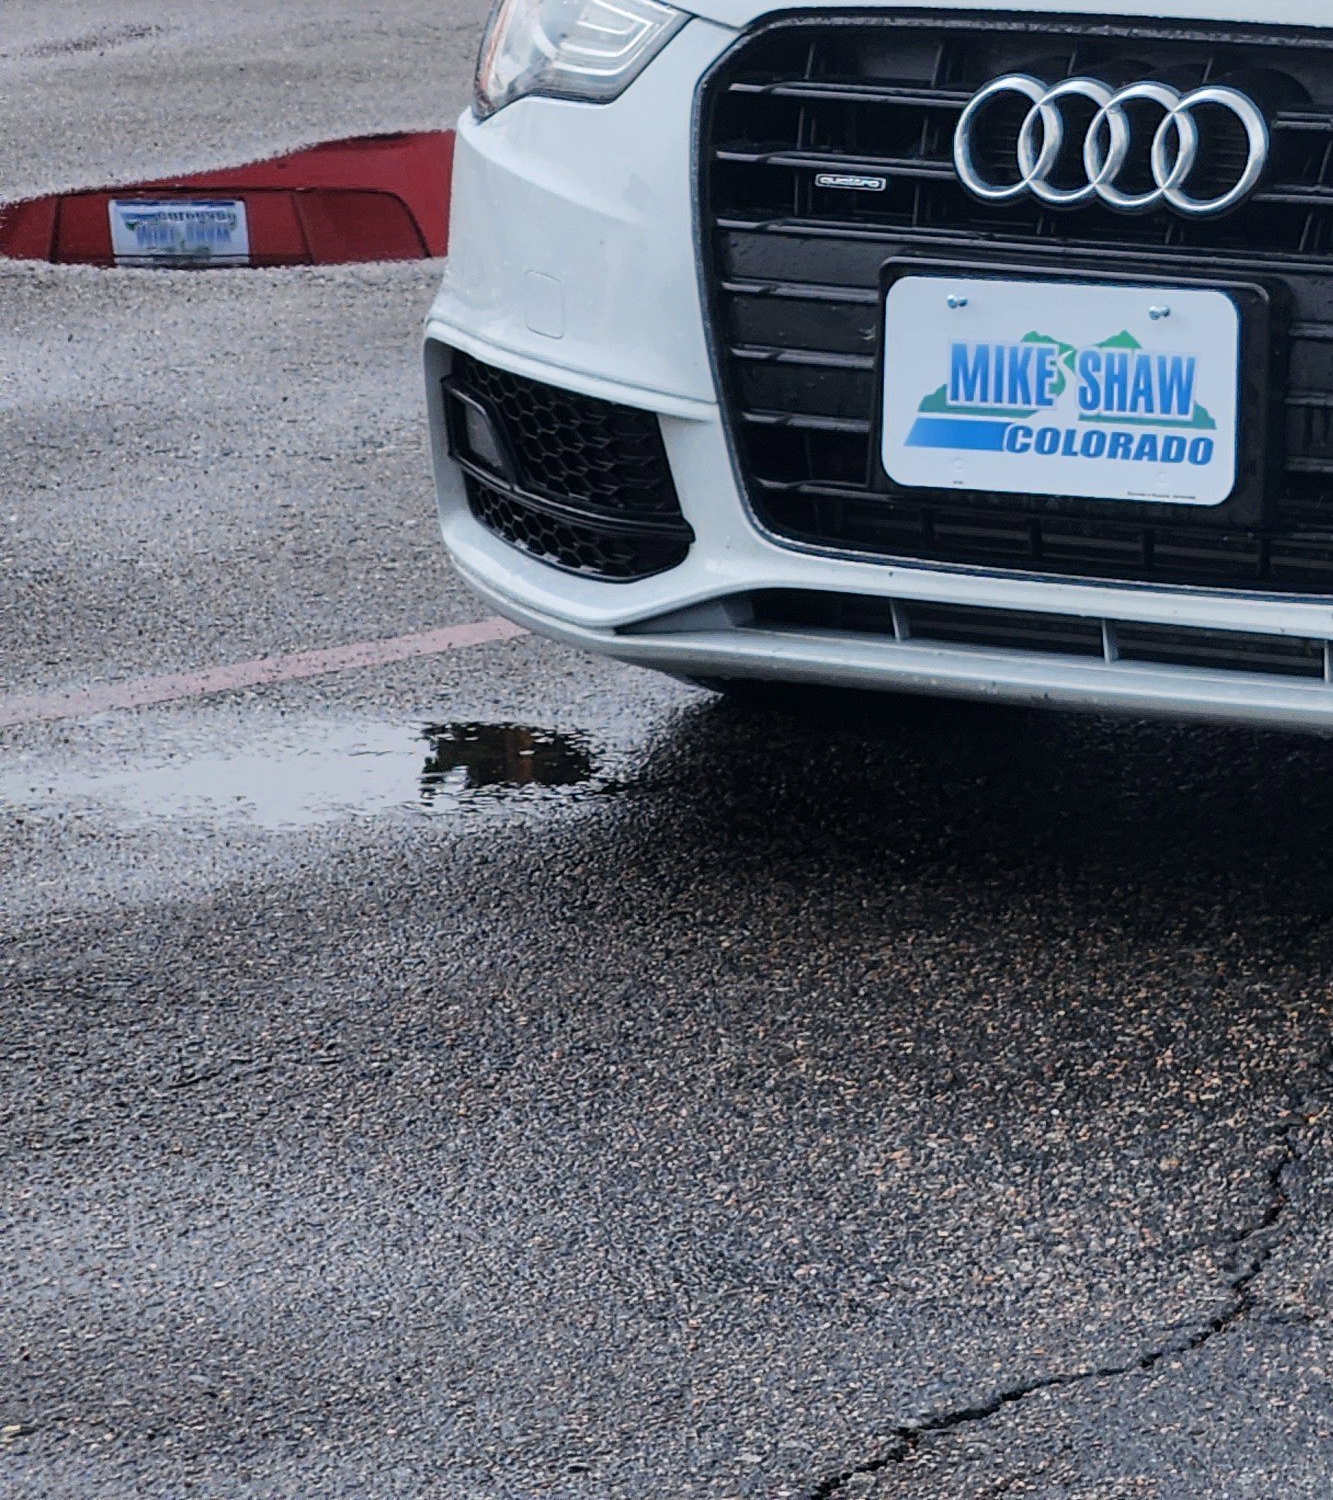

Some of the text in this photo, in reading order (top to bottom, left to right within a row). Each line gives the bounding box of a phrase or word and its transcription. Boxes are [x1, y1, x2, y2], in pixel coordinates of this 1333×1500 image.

[950, 342, 1196, 417] MIKE SHAW
[1005, 424, 1214, 466] COLORADO
